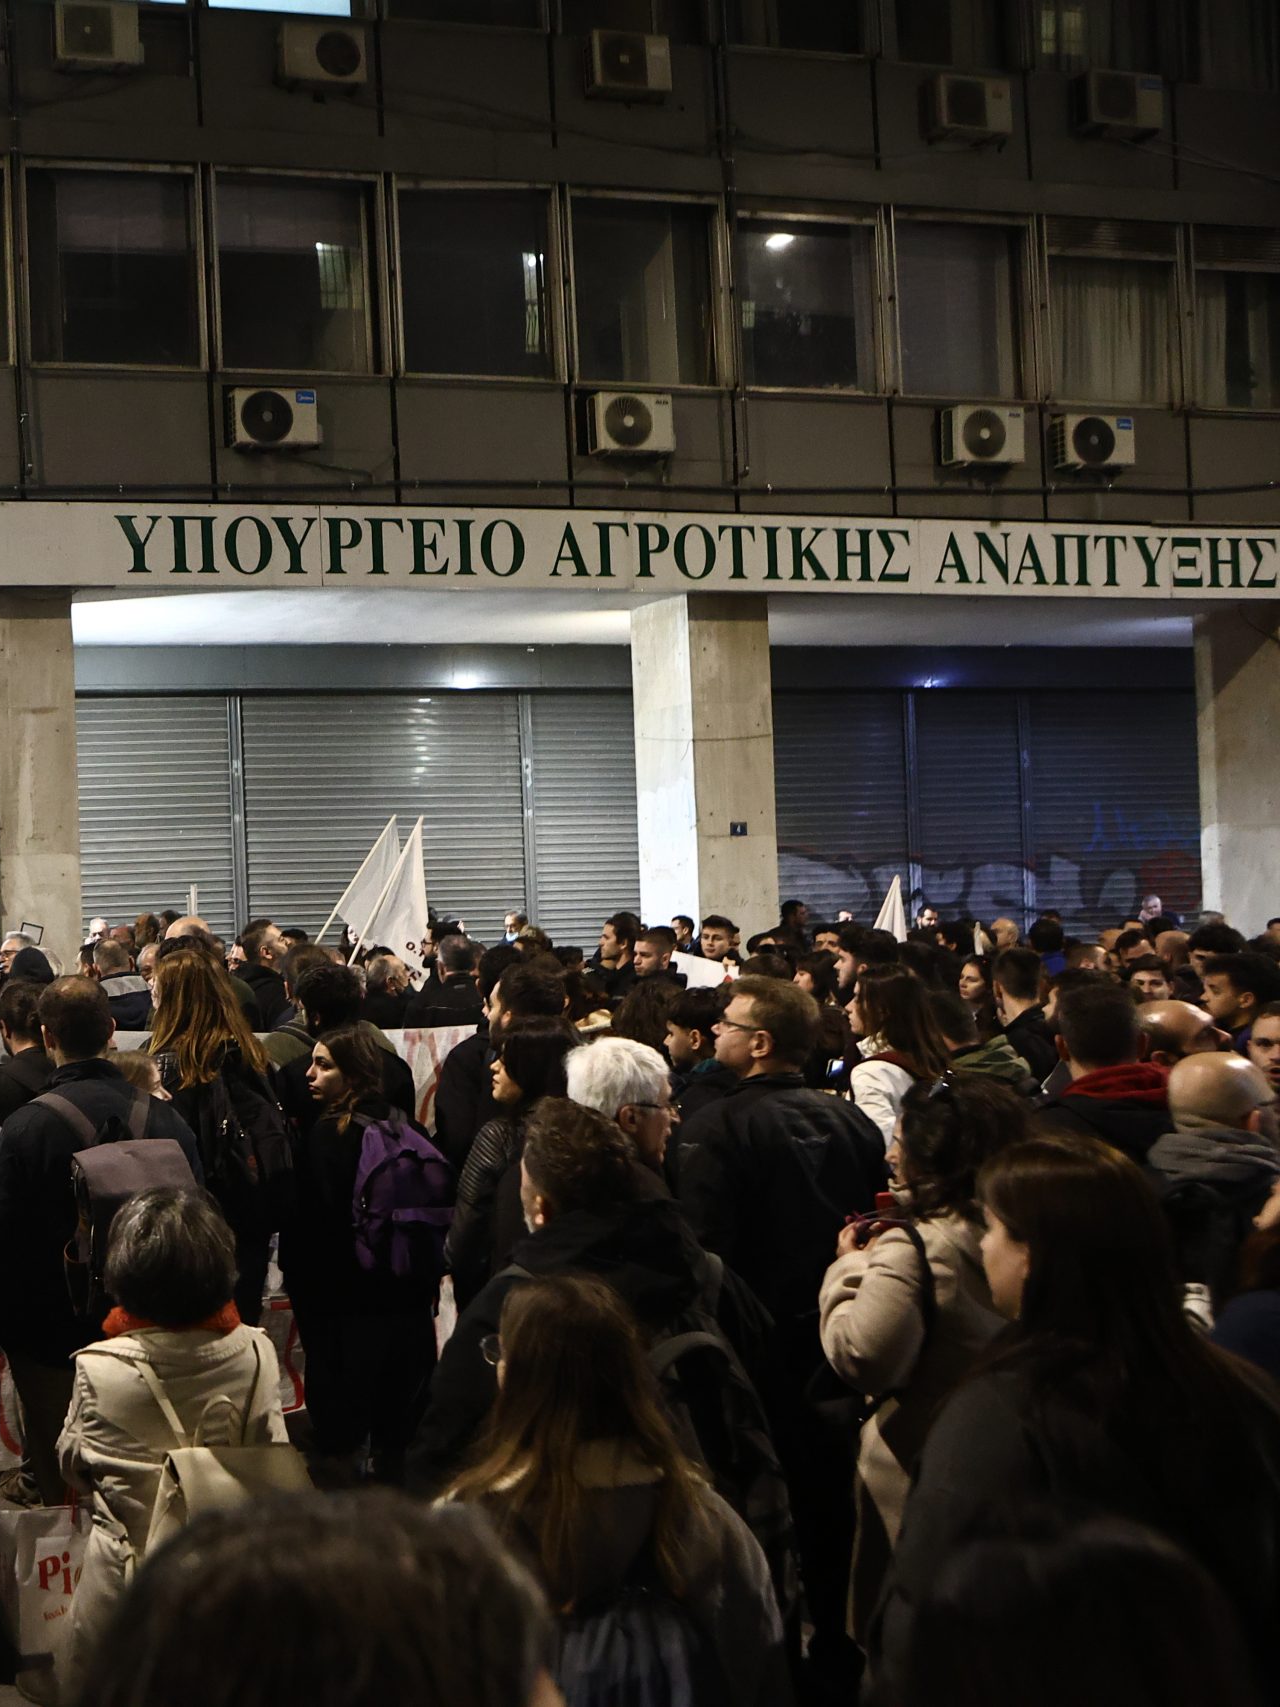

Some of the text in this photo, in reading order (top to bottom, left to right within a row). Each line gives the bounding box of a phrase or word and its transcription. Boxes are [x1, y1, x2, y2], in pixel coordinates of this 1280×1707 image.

[114, 514, 1279, 589] ΥΠΟΥΡΓΕΙΟ ΑΓΡΟΤΙΚΗΣ ΑΝΑΠΤΥΞΗΣ
